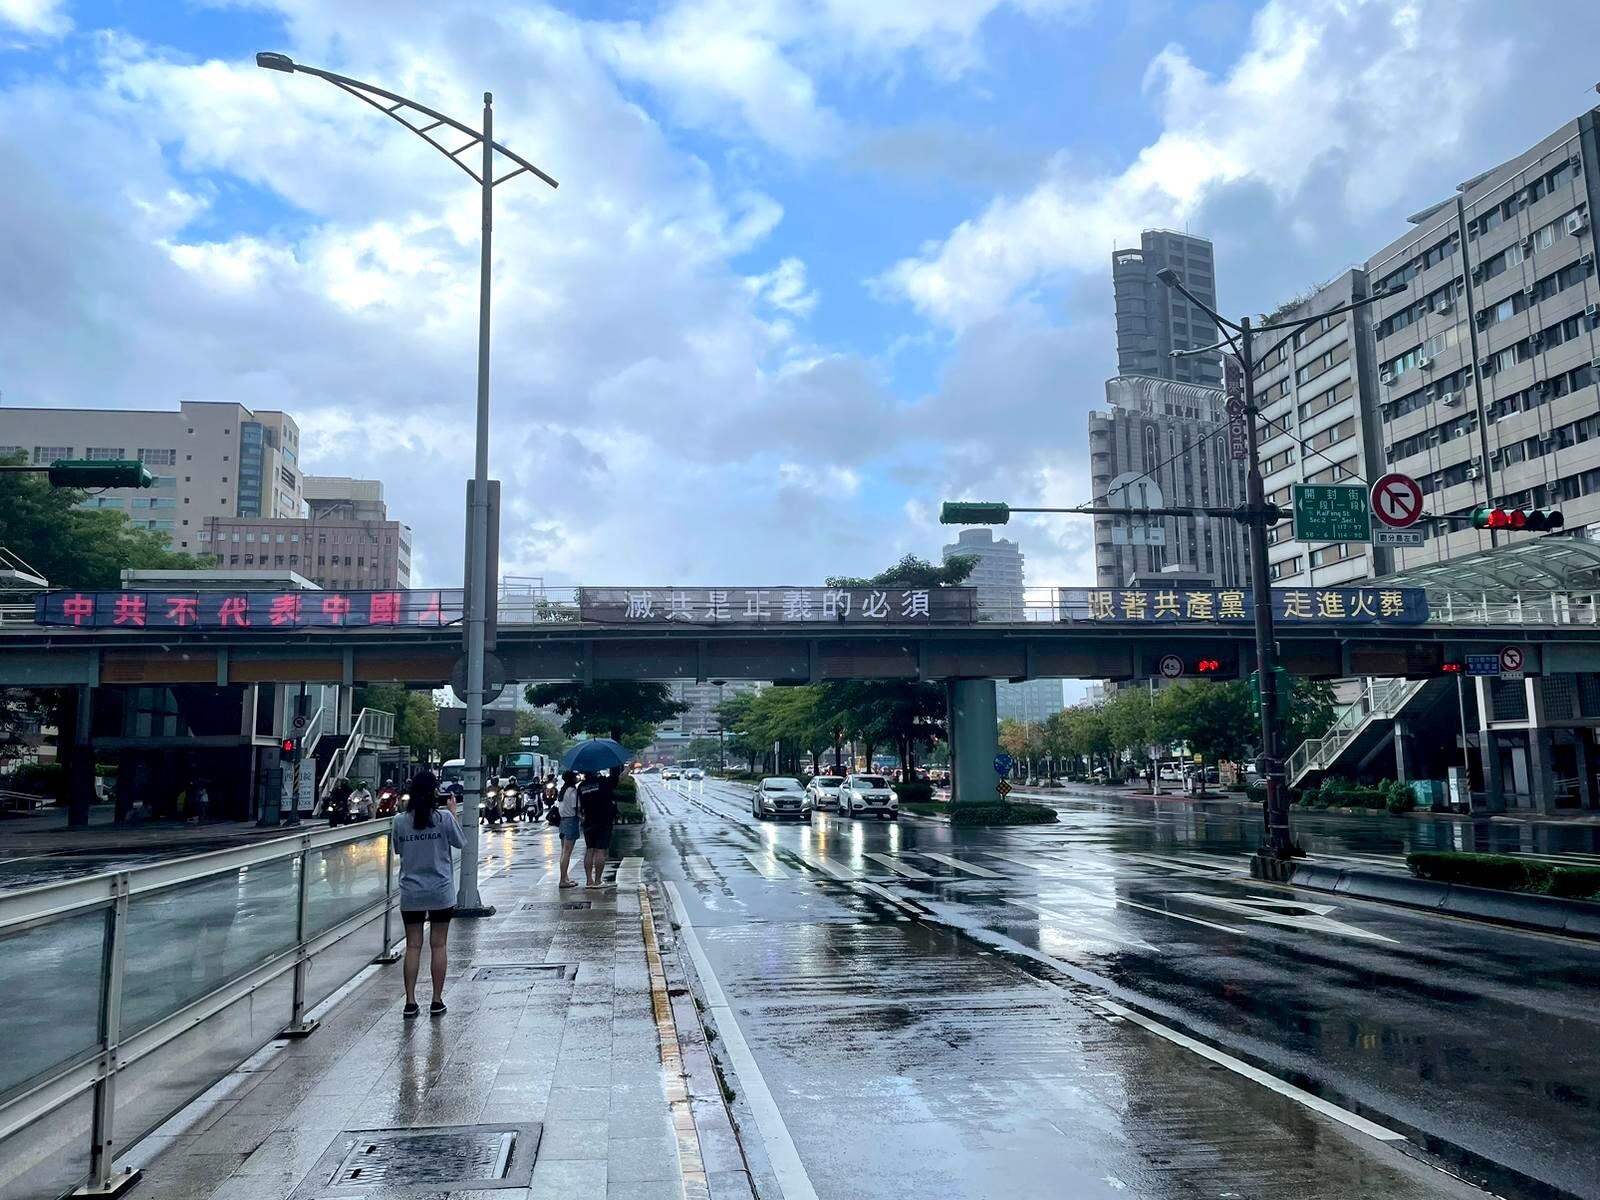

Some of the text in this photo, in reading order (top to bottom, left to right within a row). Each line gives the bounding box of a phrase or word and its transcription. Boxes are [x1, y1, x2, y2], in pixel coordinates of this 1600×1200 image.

[1304, 488, 1359, 501] 開封街
[63, 592, 449, 627] 中共不代表中國人
[624, 589, 930, 619] 滅共是正義的必須
[1087, 589, 1405, 619] 跟著共產黨 走進火葬
